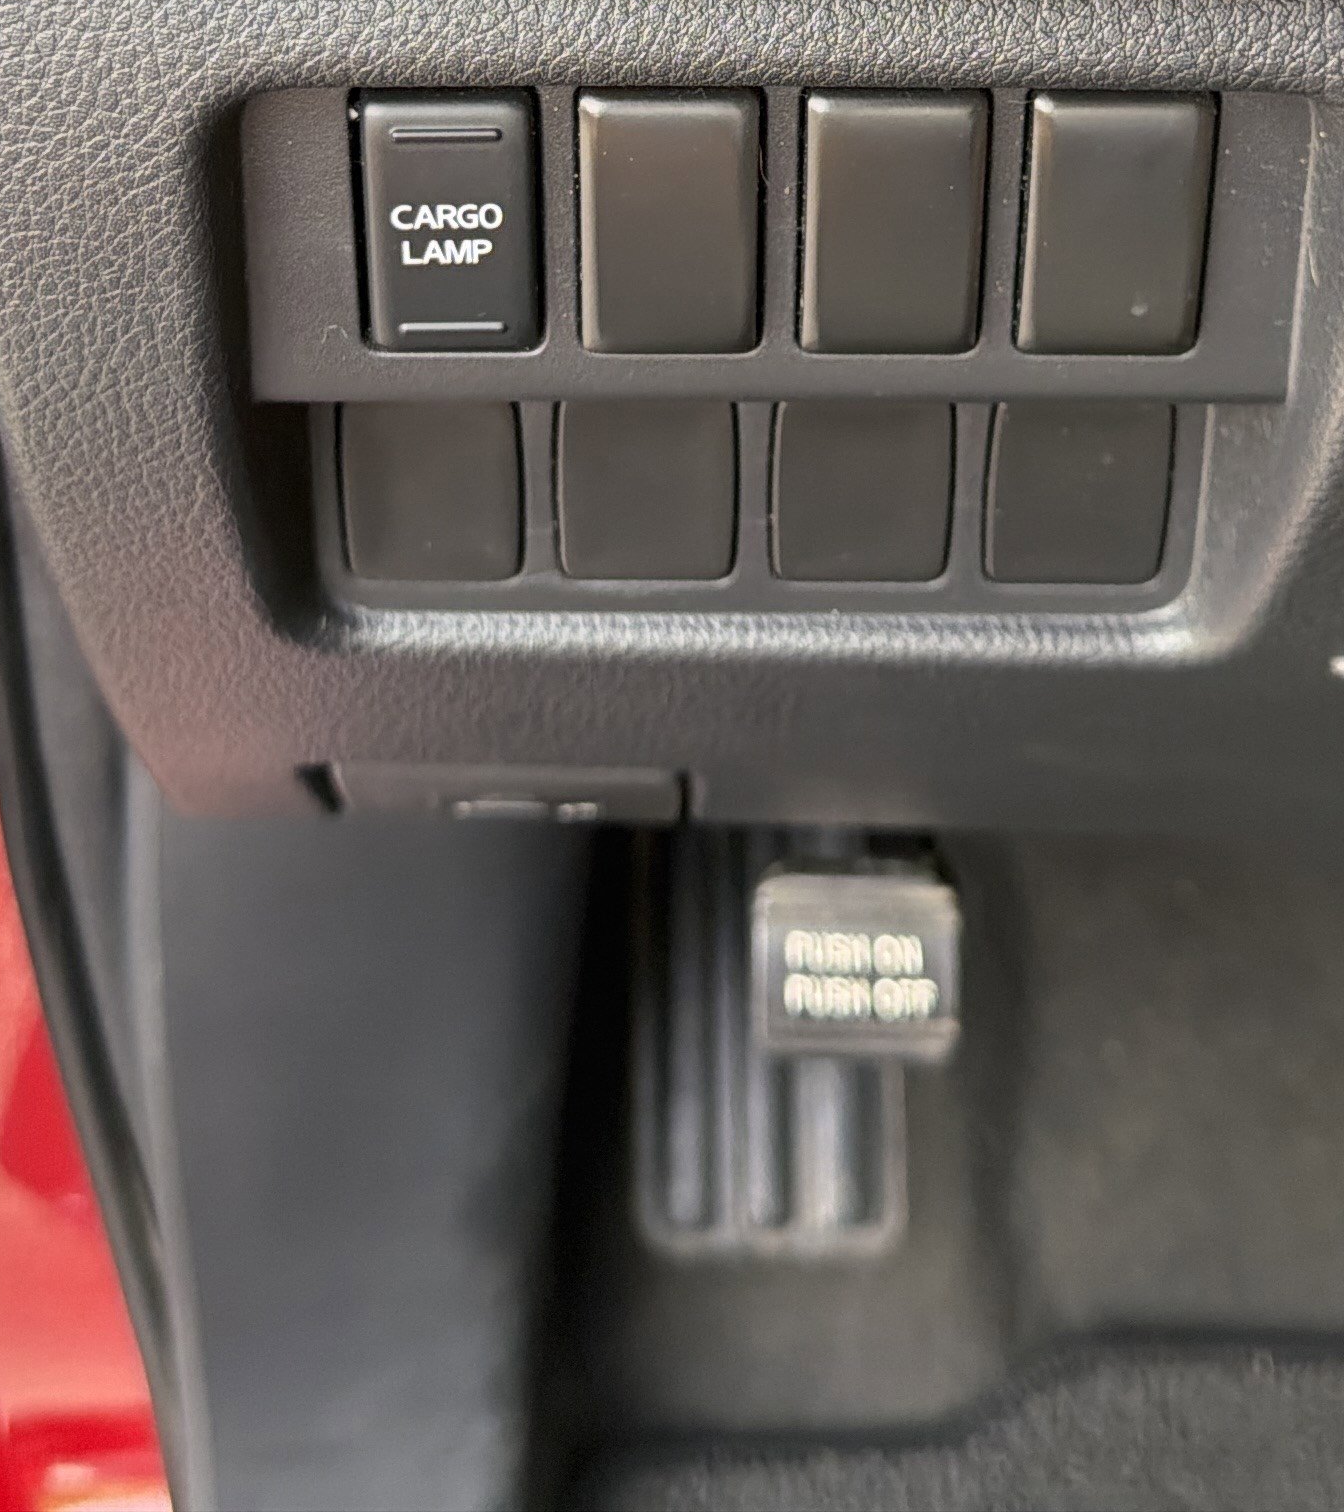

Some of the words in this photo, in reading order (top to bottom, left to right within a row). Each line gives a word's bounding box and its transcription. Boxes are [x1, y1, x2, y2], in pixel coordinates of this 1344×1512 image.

[389, 203, 504, 231] CARGO
[400, 239, 494, 266] LAMP
[873, 934, 923, 975] ON
[873, 978, 939, 1021] OFF
